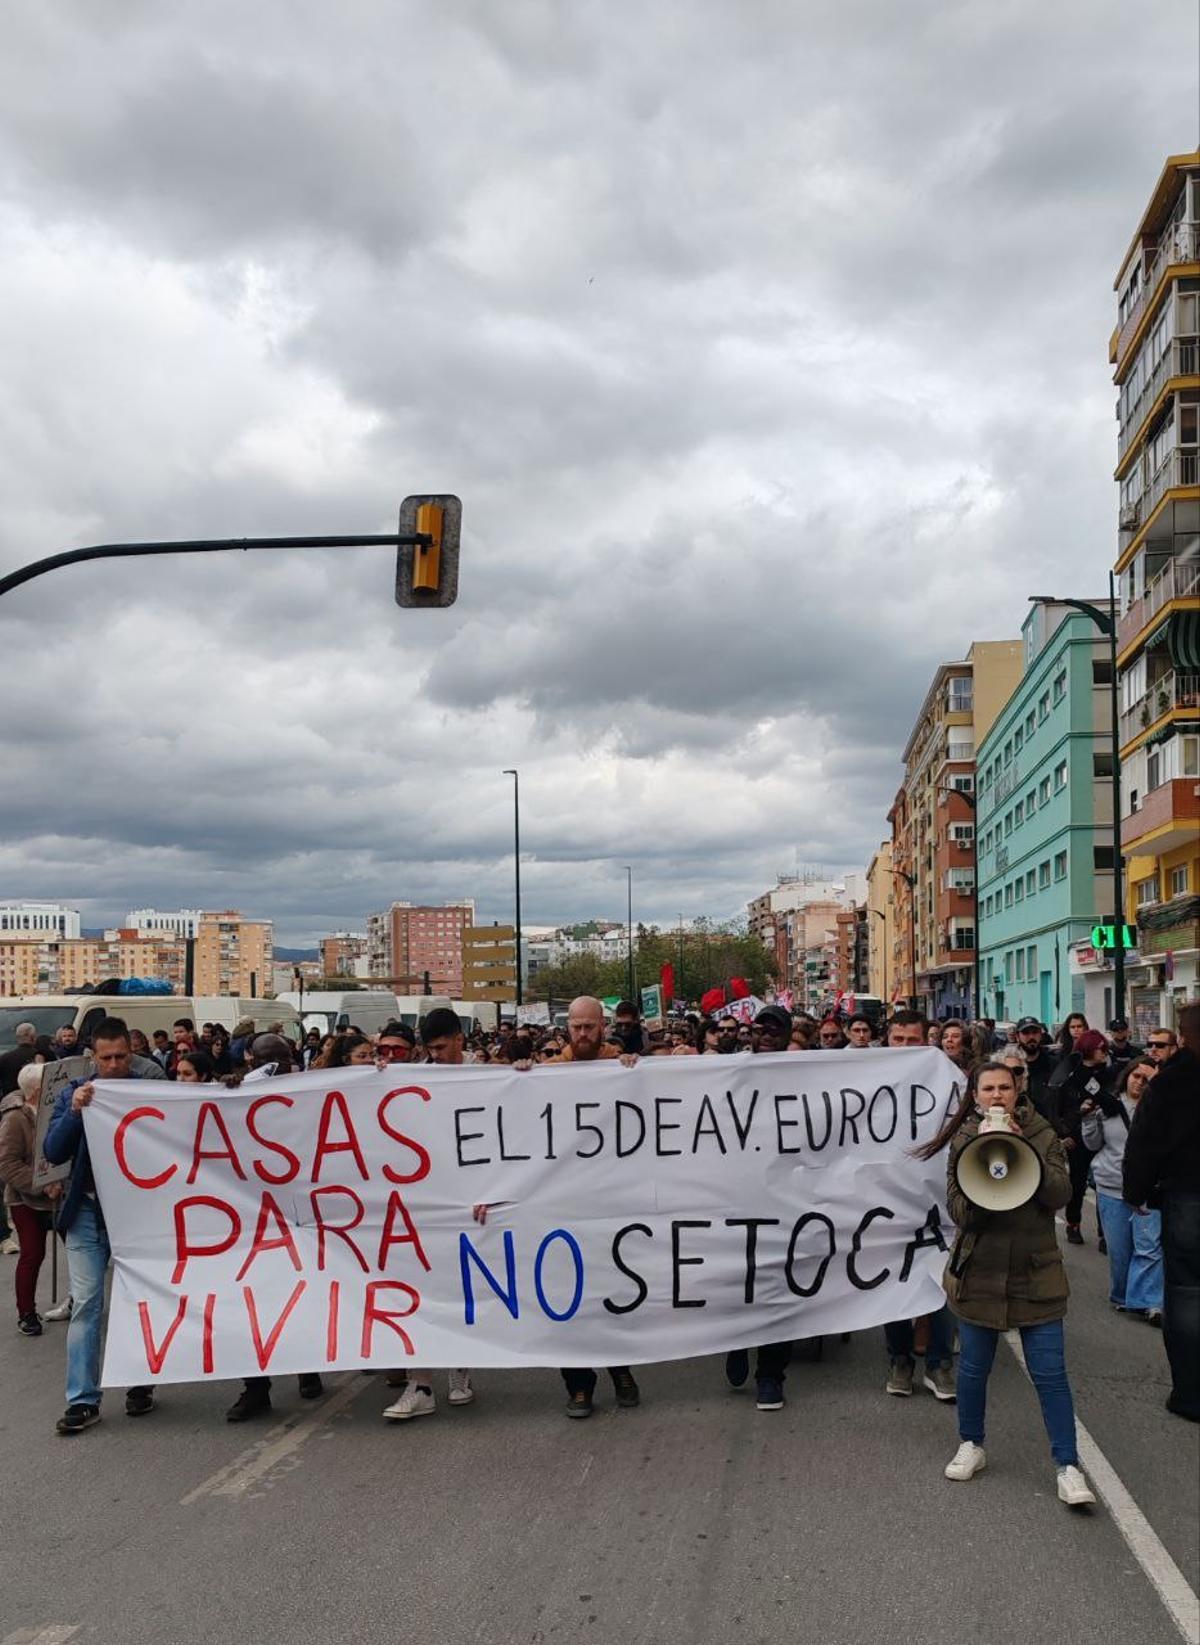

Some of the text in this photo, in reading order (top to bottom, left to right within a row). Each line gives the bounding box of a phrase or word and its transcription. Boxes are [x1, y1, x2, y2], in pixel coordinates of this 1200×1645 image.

[113, 1085, 432, 1190] CASAS
[171, 1184, 432, 1285] PARA
[459, 1228, 584, 1325] NO
[138, 1279, 421, 1375] VIVIR
